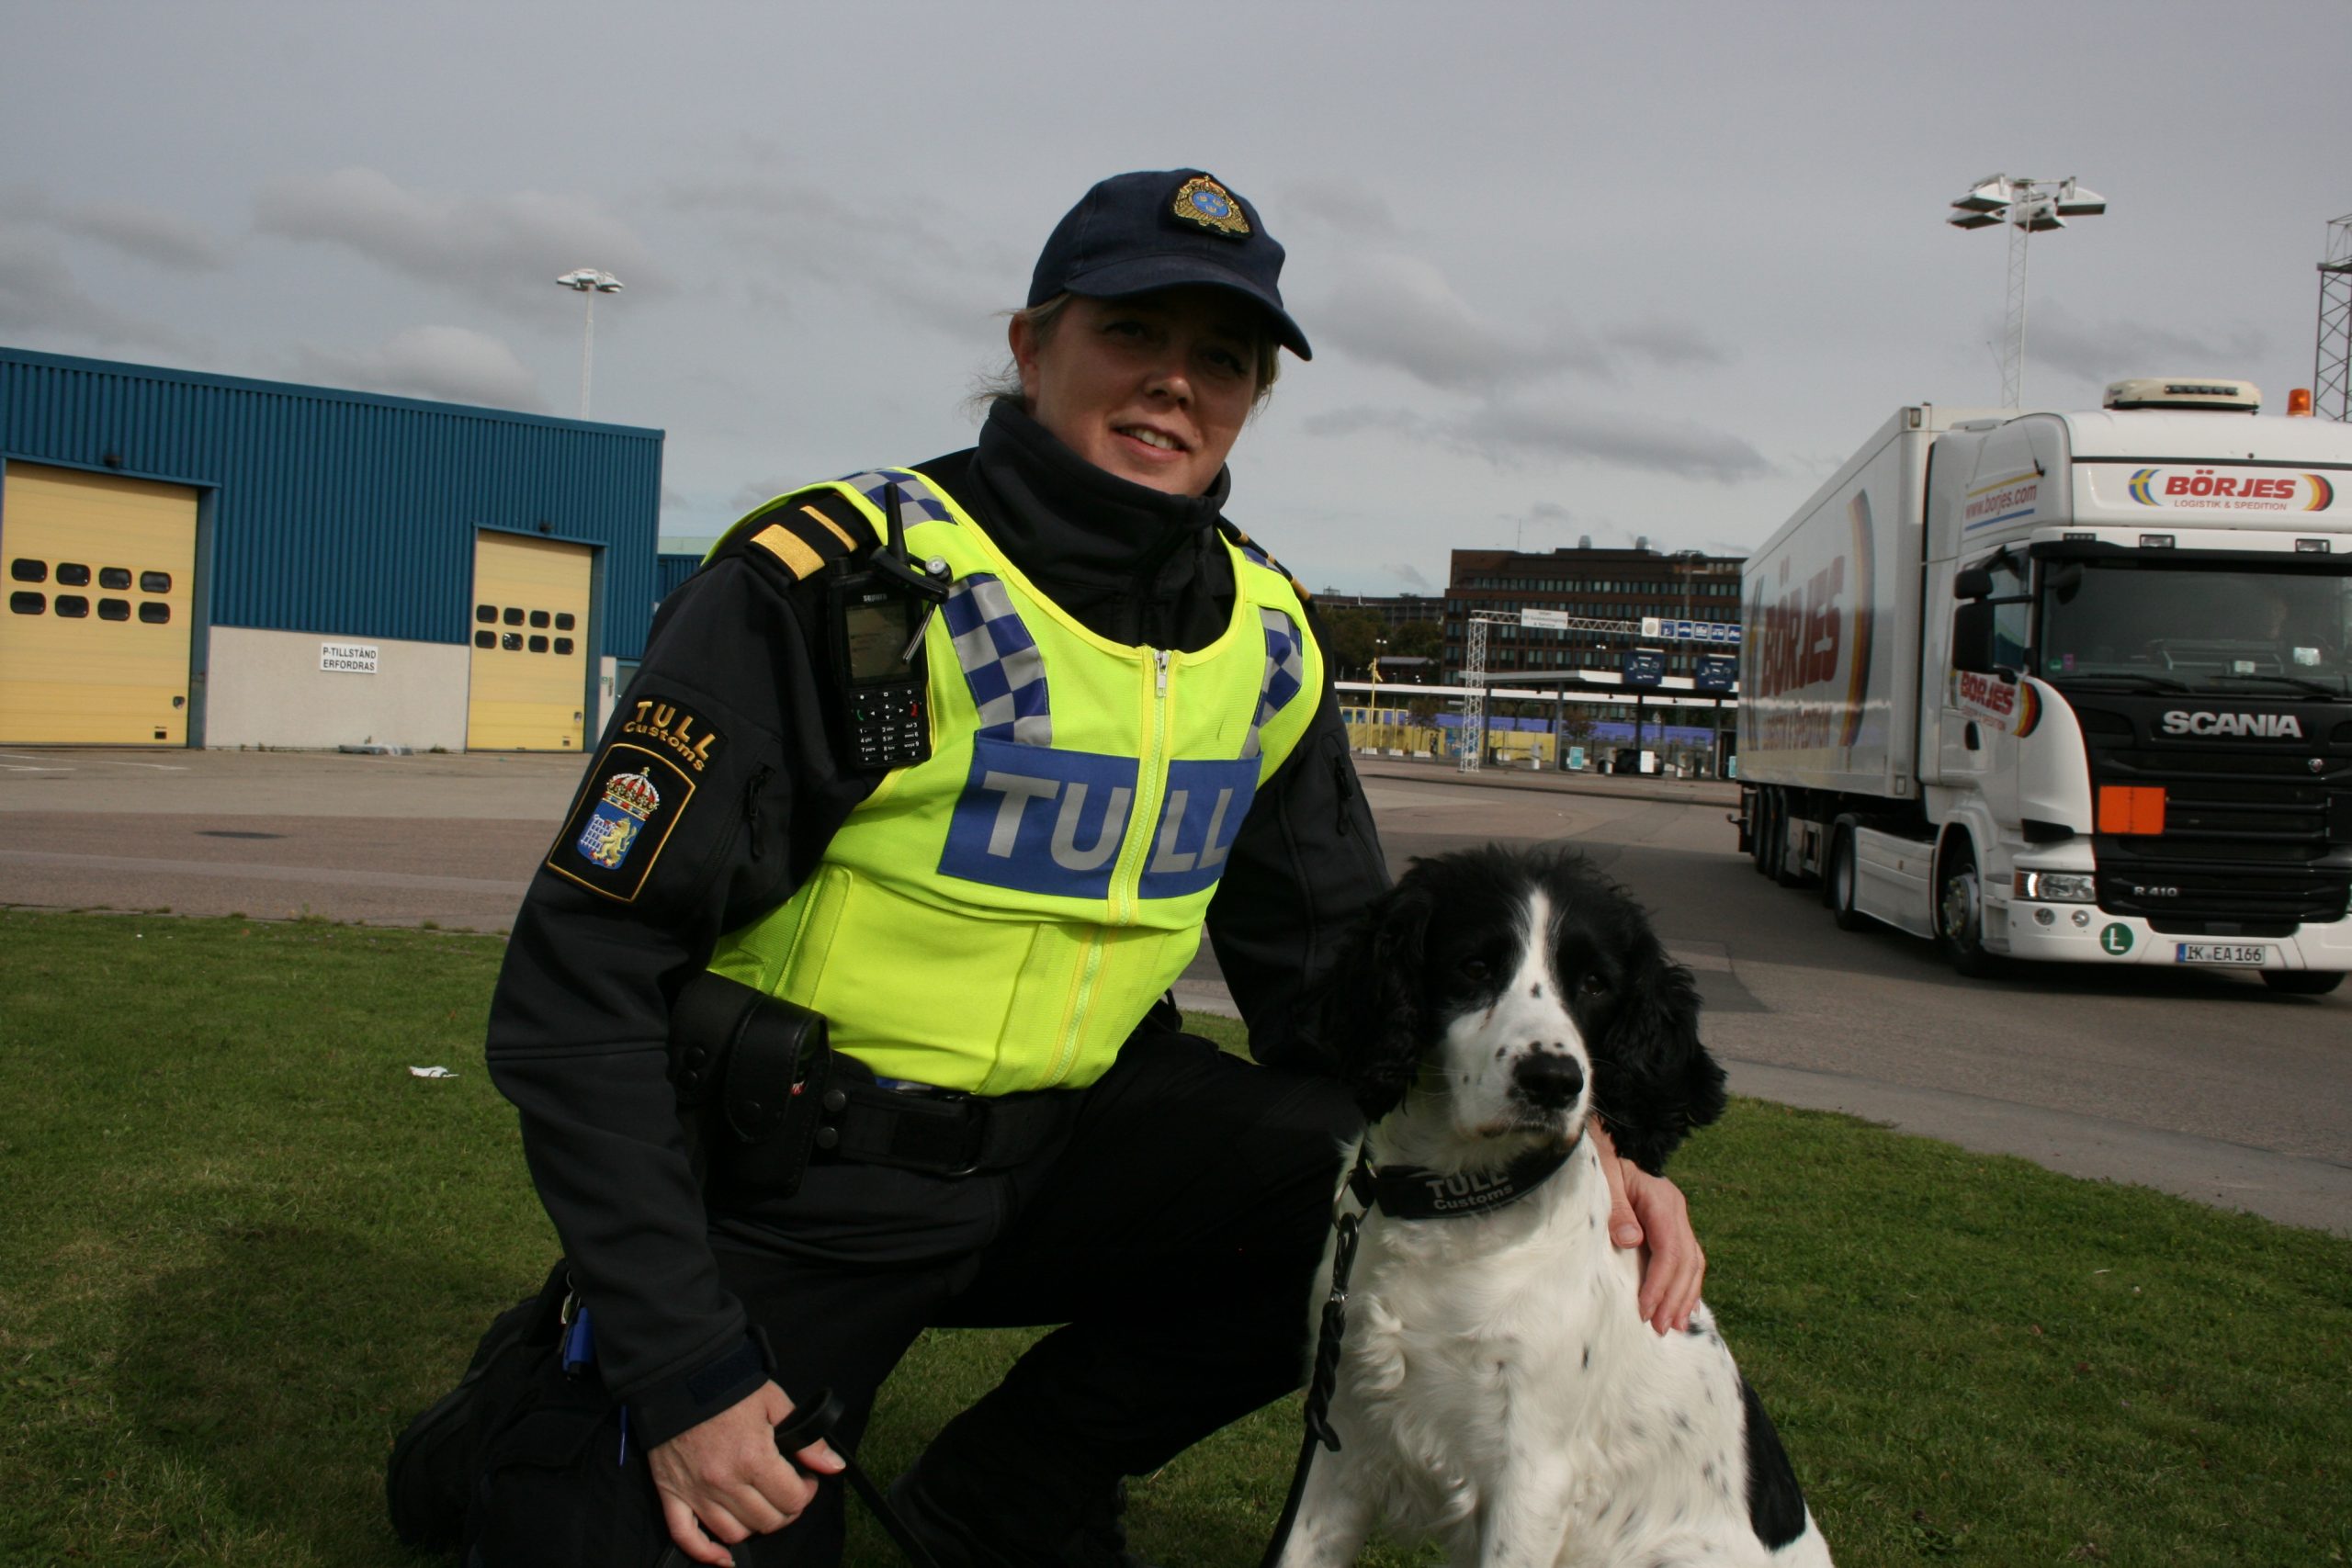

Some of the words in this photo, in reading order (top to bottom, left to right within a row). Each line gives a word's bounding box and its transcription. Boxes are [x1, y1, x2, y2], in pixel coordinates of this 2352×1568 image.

[2165, 469, 2296, 499] BÖRJES
[2174, 500, 2221, 508] LOGISTIK
[2234, 502, 2287, 511] SPEDITION
[322, 647, 377, 659] P-TILLSTÅND
[323, 659, 375, 671] ERFORDRAS
[636, 701, 716, 761] TULL
[2162, 710, 2302, 738] SCANIA
[624, 721, 705, 772] Customs
[983, 770, 1233, 874] TULL
[2134, 886, 2144, 896] R
[2148, 886, 2177, 897] 410
[2213, 947, 2233, 961] EA
[2235, 948, 2262, 962] 166
[1425, 1172, 1509, 1199] TULL
[1433, 1185, 1513, 1210] Customs
